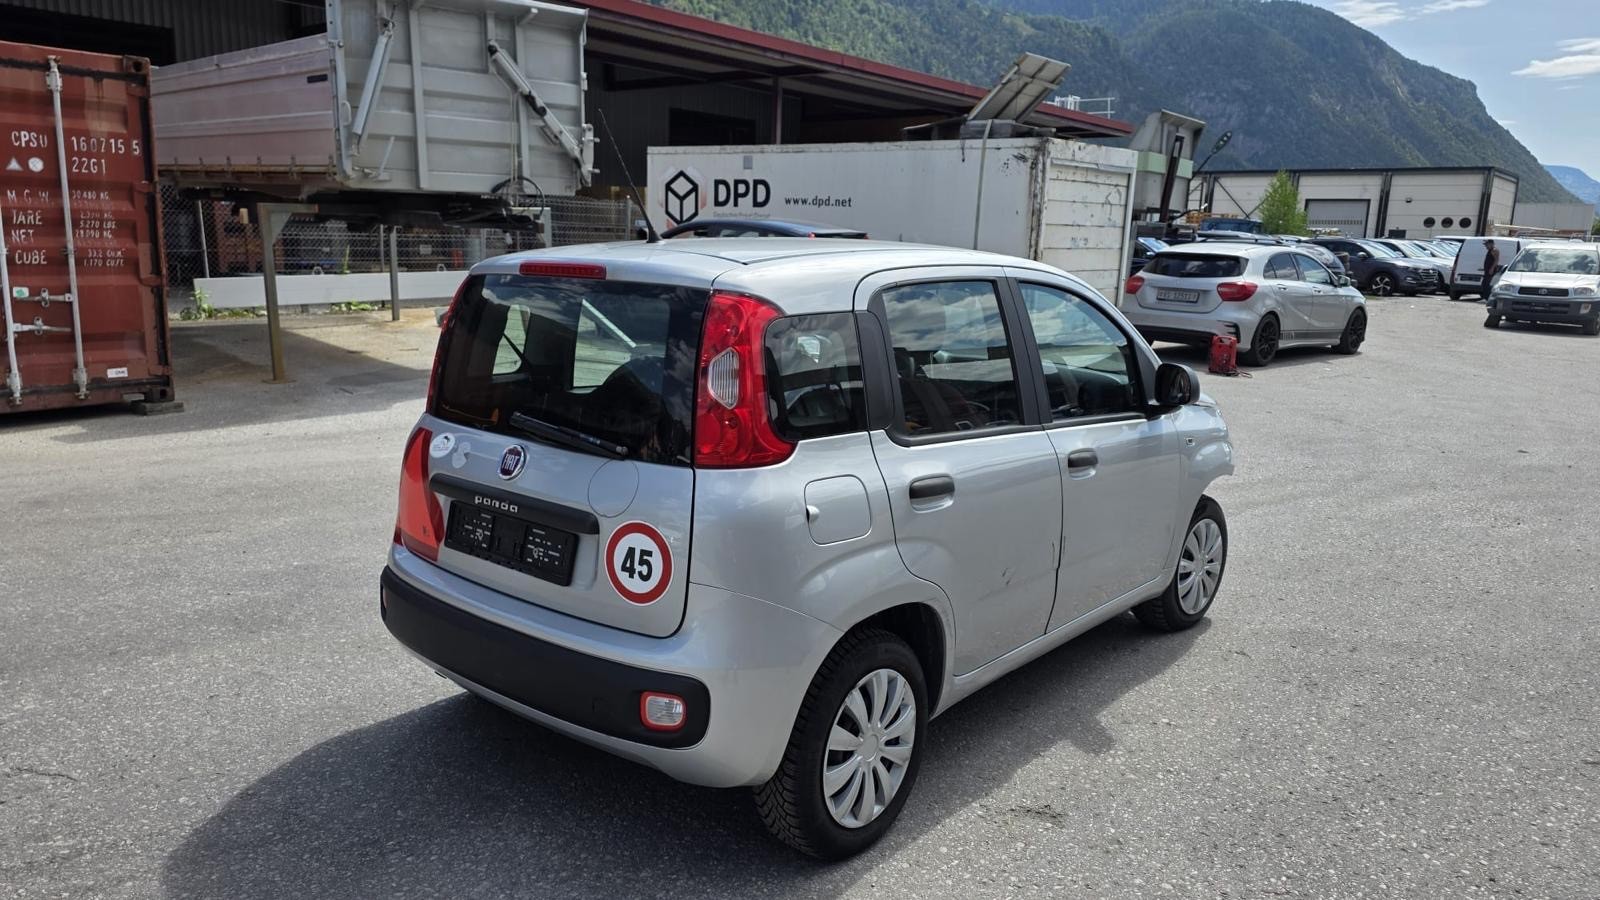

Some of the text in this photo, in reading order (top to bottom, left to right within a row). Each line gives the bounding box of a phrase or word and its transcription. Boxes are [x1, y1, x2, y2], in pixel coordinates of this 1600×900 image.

[11, 131, 48, 148] CPSU
[71, 157, 107, 175] 22G1
[713, 179, 771, 208] DPD
[784, 196, 852, 208] www.dpd.net
[12, 209, 43, 225] TARE
[11, 229, 35, 244] NET
[15, 249, 48, 265] CUBE
[503, 451, 519, 471] FIAT
[620, 546, 654, 582] 45
